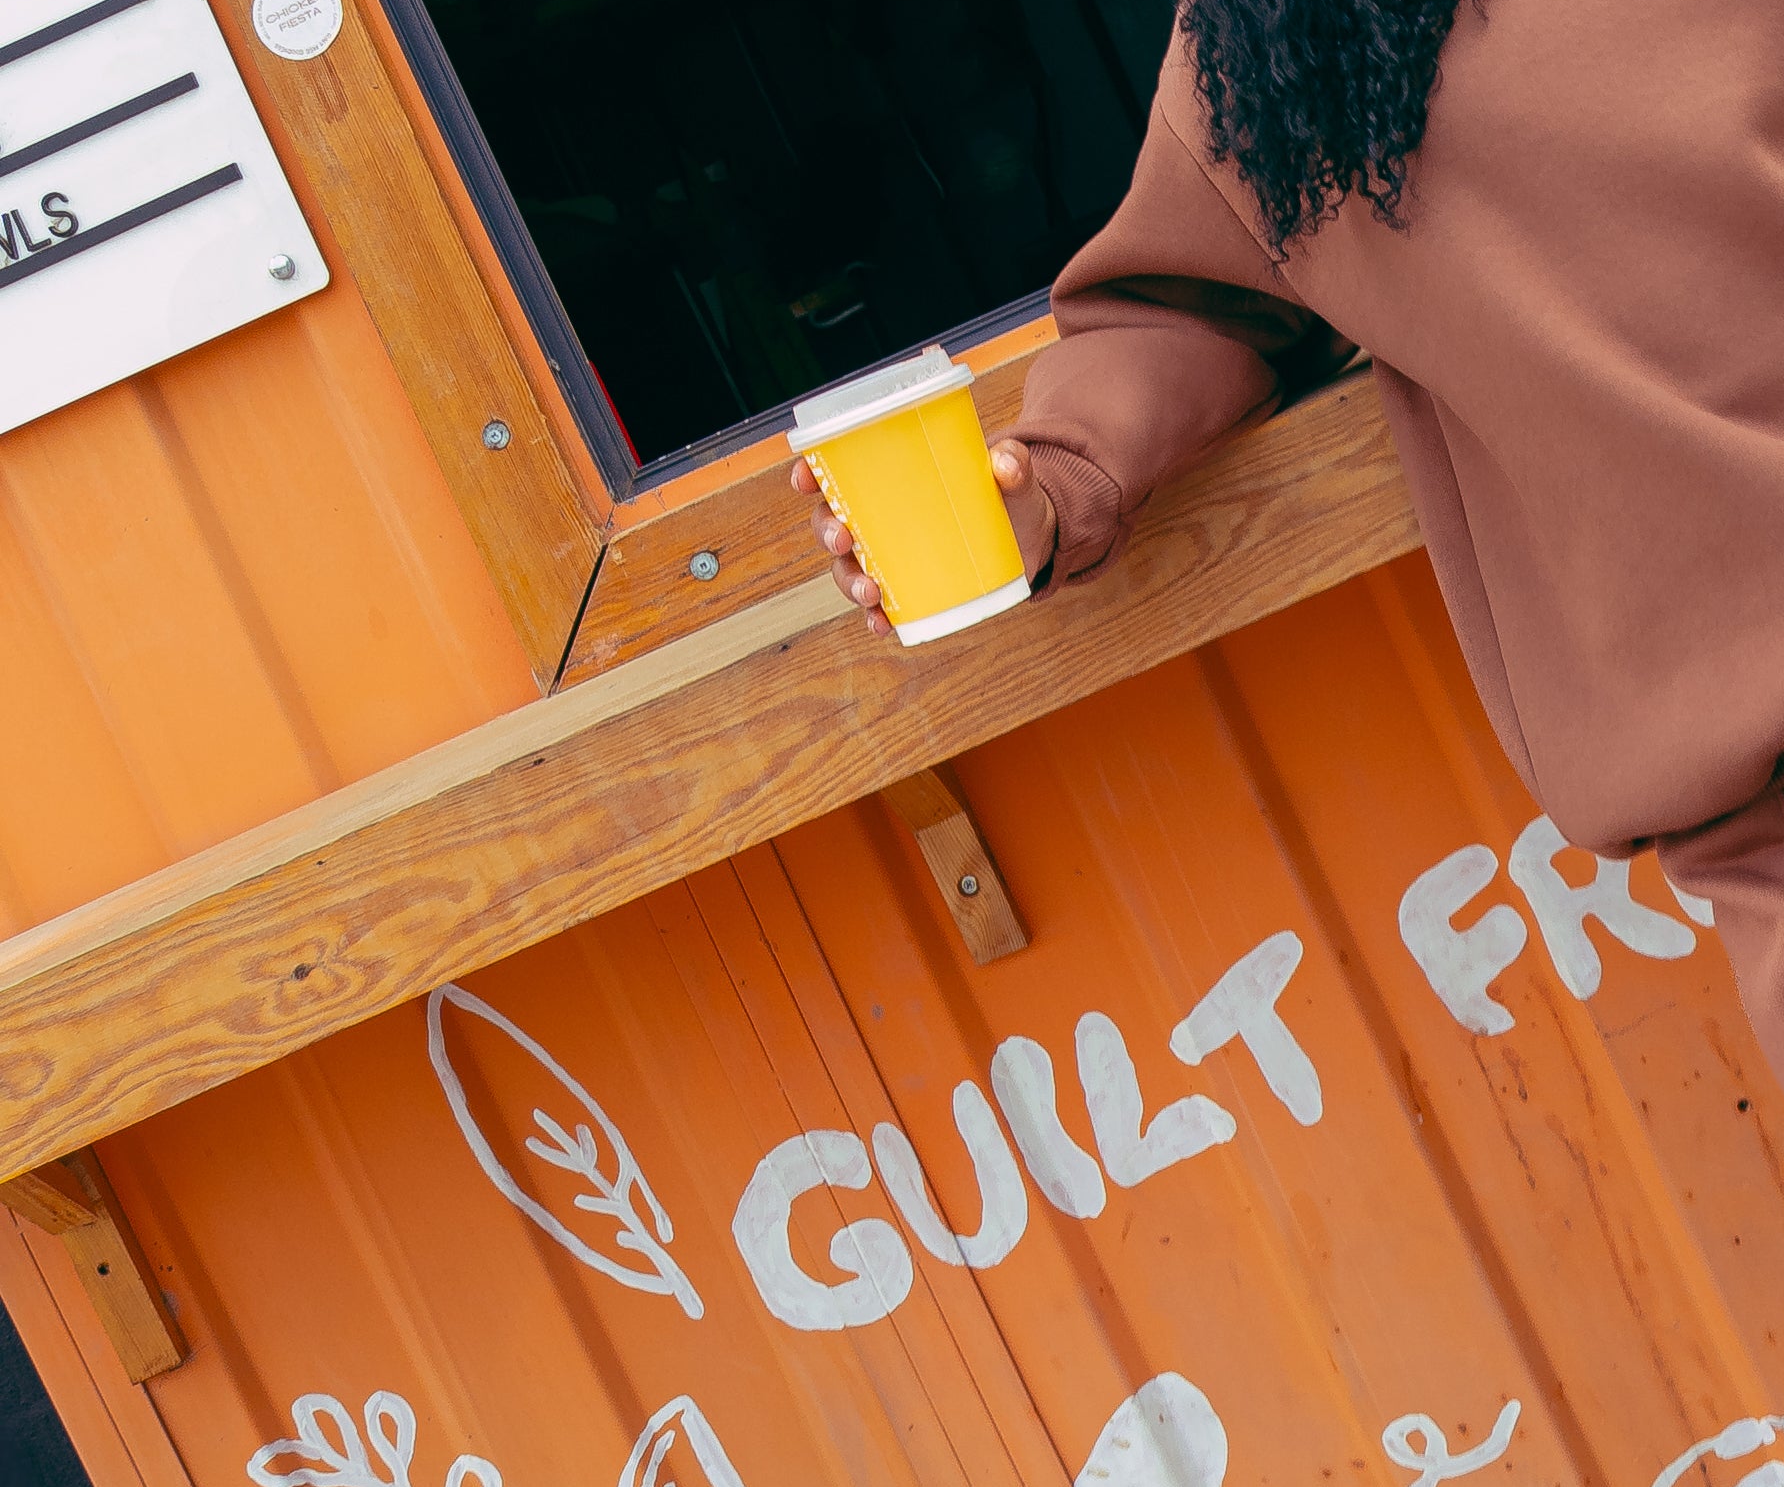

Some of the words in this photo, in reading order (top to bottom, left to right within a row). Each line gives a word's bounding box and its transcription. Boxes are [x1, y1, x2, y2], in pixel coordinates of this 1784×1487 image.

[279, 7, 322, 32] FIESTA
[733, 931, 1323, 1331] GUILT
[1399, 814, 1715, 1036] FR
